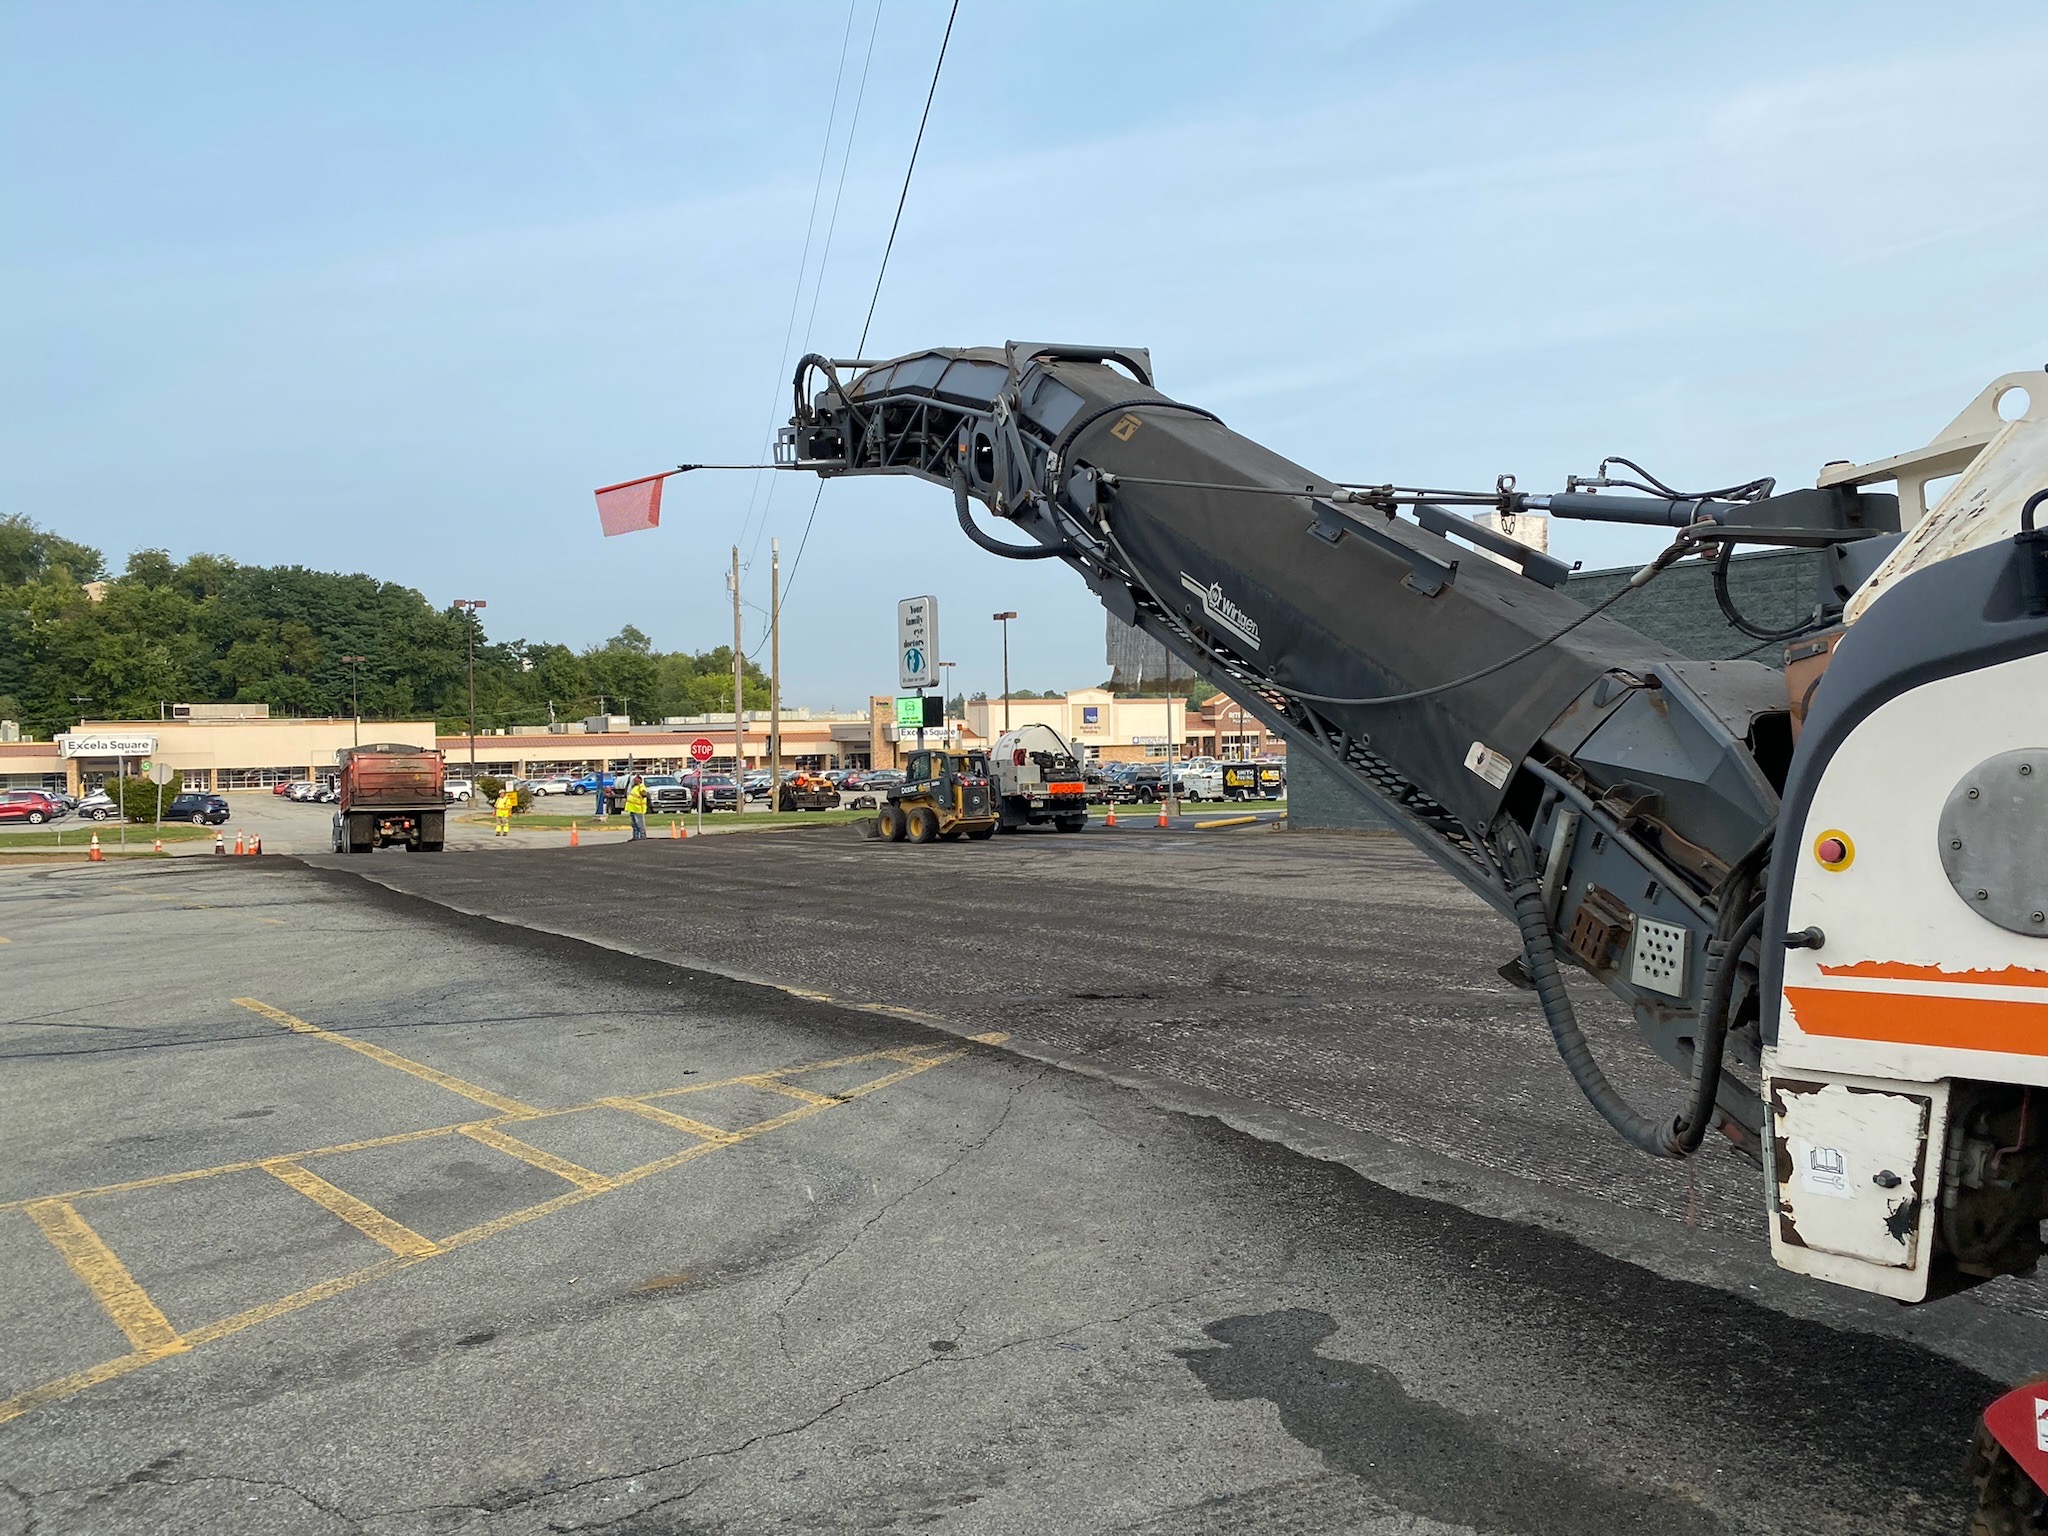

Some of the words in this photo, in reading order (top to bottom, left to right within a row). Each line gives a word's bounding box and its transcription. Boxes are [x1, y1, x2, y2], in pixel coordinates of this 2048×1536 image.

[909, 605, 923, 614] Your
[905, 615, 923, 627] family
[1222, 597, 1259, 636] Wirtgen
[913, 628, 924, 638] eye
[68, 741, 108, 750] Excela
[110, 741, 150, 750] Square
[691, 745, 713, 755] STOP
[901, 786, 918, 794] DEERE
